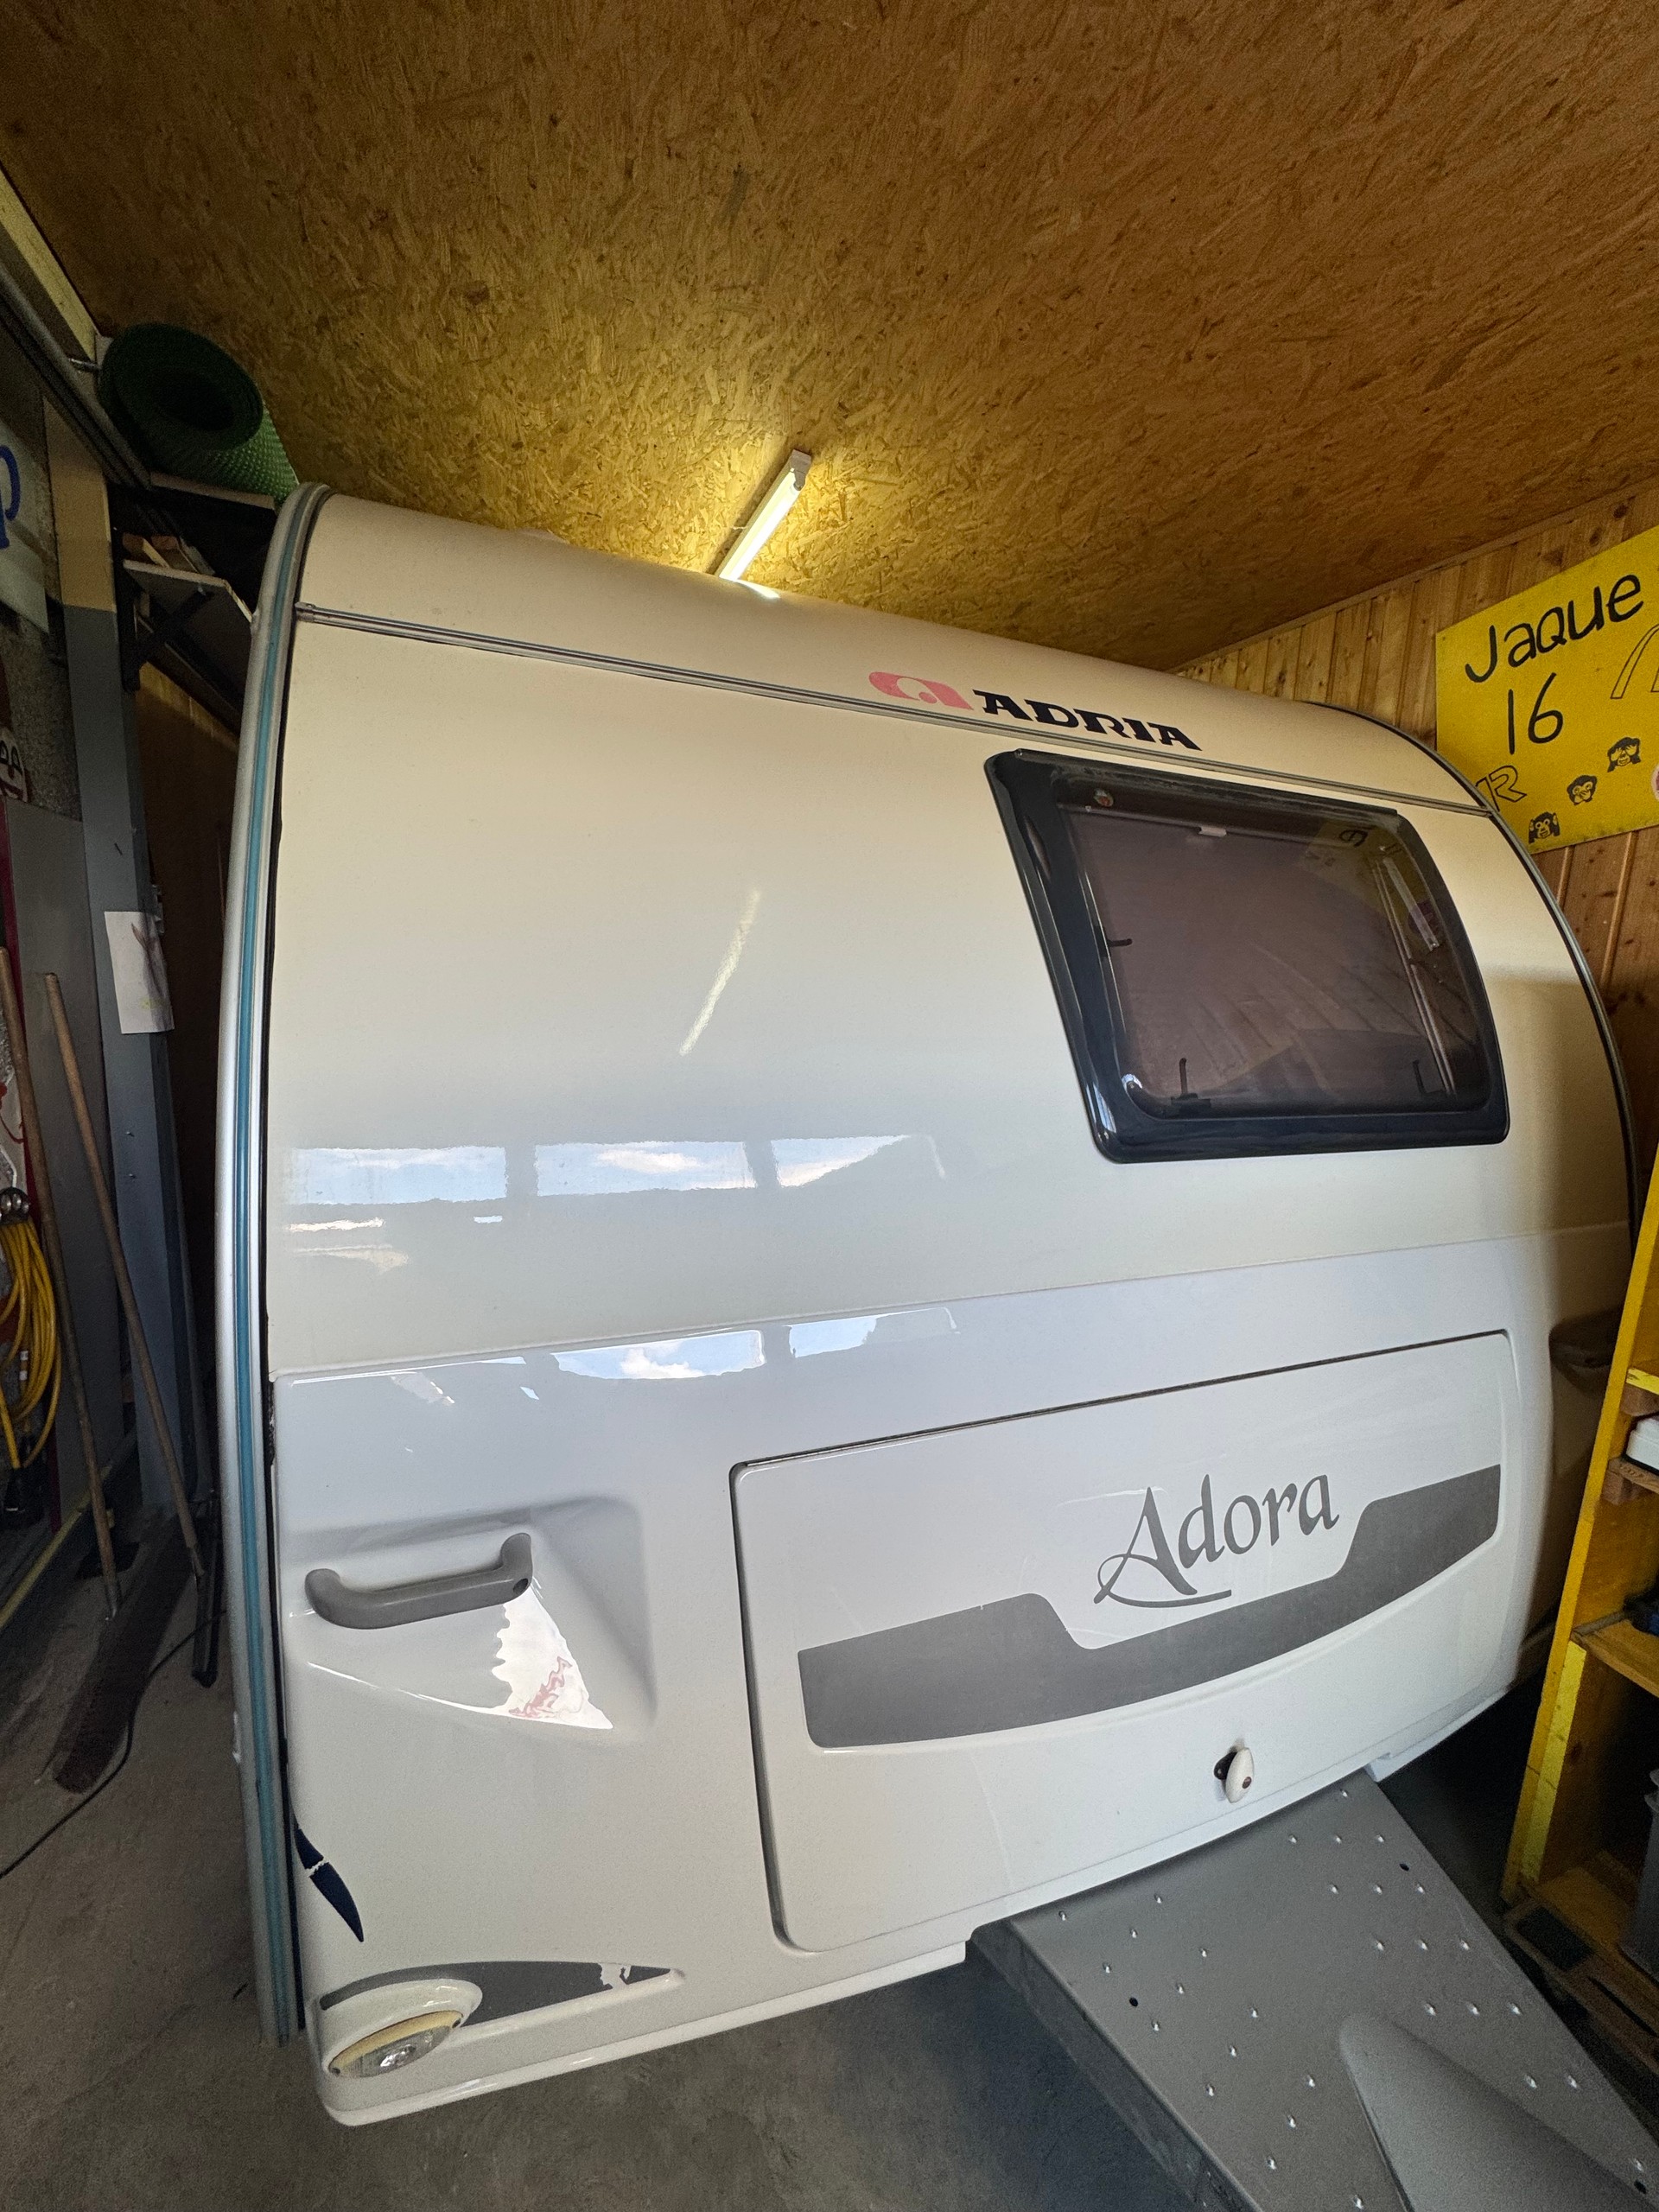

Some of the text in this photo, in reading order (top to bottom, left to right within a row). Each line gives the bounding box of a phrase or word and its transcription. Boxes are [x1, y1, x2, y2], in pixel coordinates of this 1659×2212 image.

[971, 689, 1204, 752] ADRIA
[1507, 672, 1564, 756] 16
[1093, 1473, 1340, 1609] Adora
